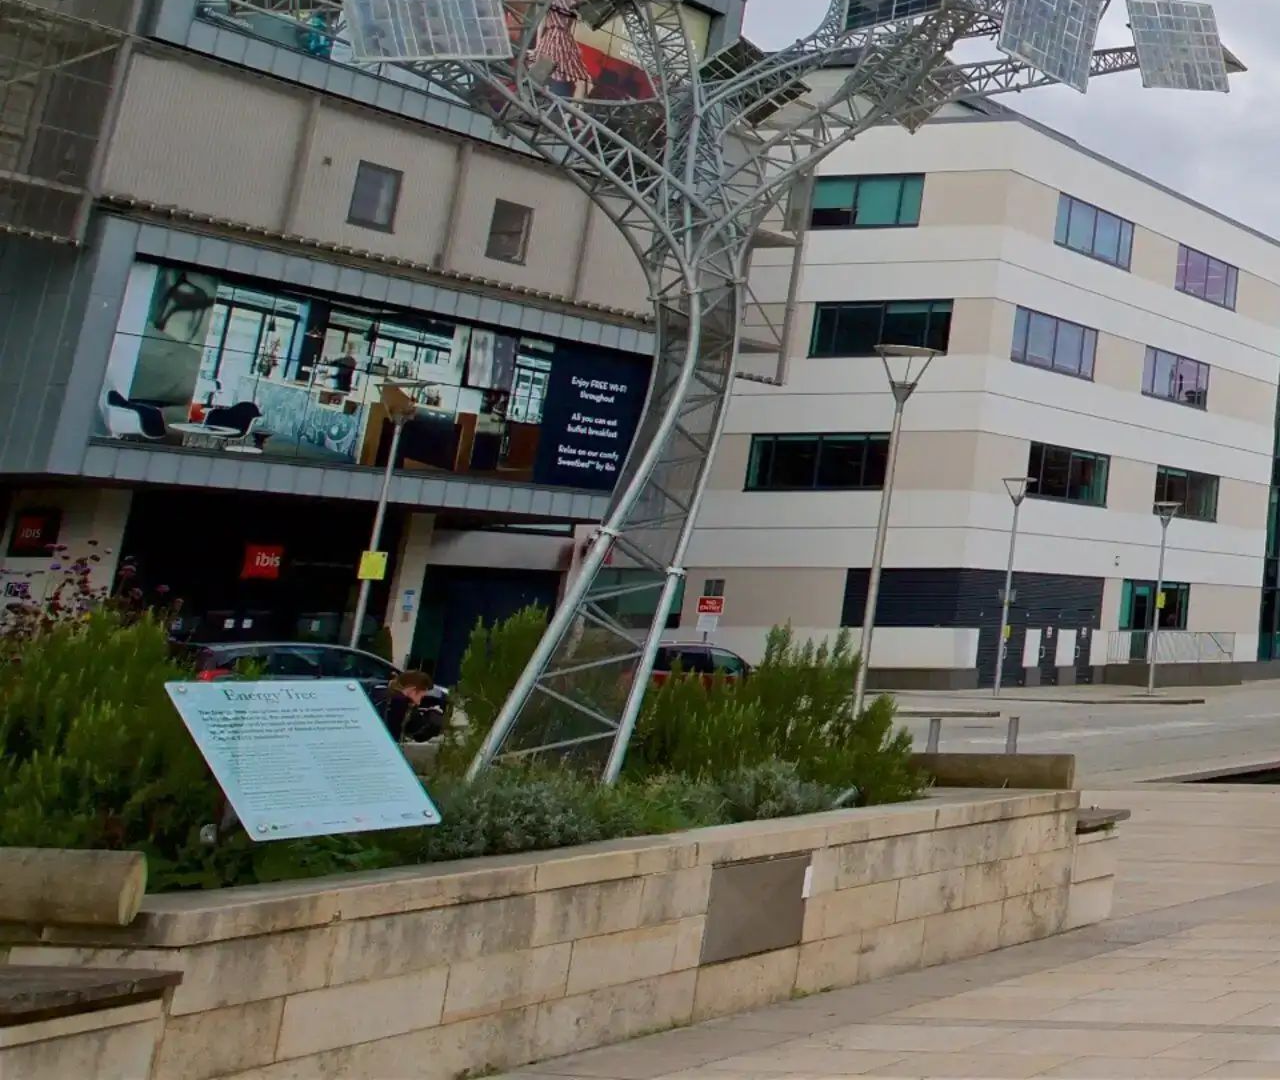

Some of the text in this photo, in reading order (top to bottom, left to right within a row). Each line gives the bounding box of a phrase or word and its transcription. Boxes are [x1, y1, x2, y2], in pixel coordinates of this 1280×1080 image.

[571, 376, 590, 389] Enjoy
[590, 379, 608, 390] FREE
[580, 390, 615, 403] throughout
[571, 413, 581, 421] All
[581, 414, 593, 423] you
[594, 417, 606, 425] can
[567, 424, 618, 438] buffet breakfast
[558, 444, 577, 455] Relax
[587, 450, 599, 458] our
[599, 451, 619, 462] comfy
[595, 461, 605, 471] by
[255, 552, 281, 568] ibis
[222, 688, 318, 704] Energy Tree
